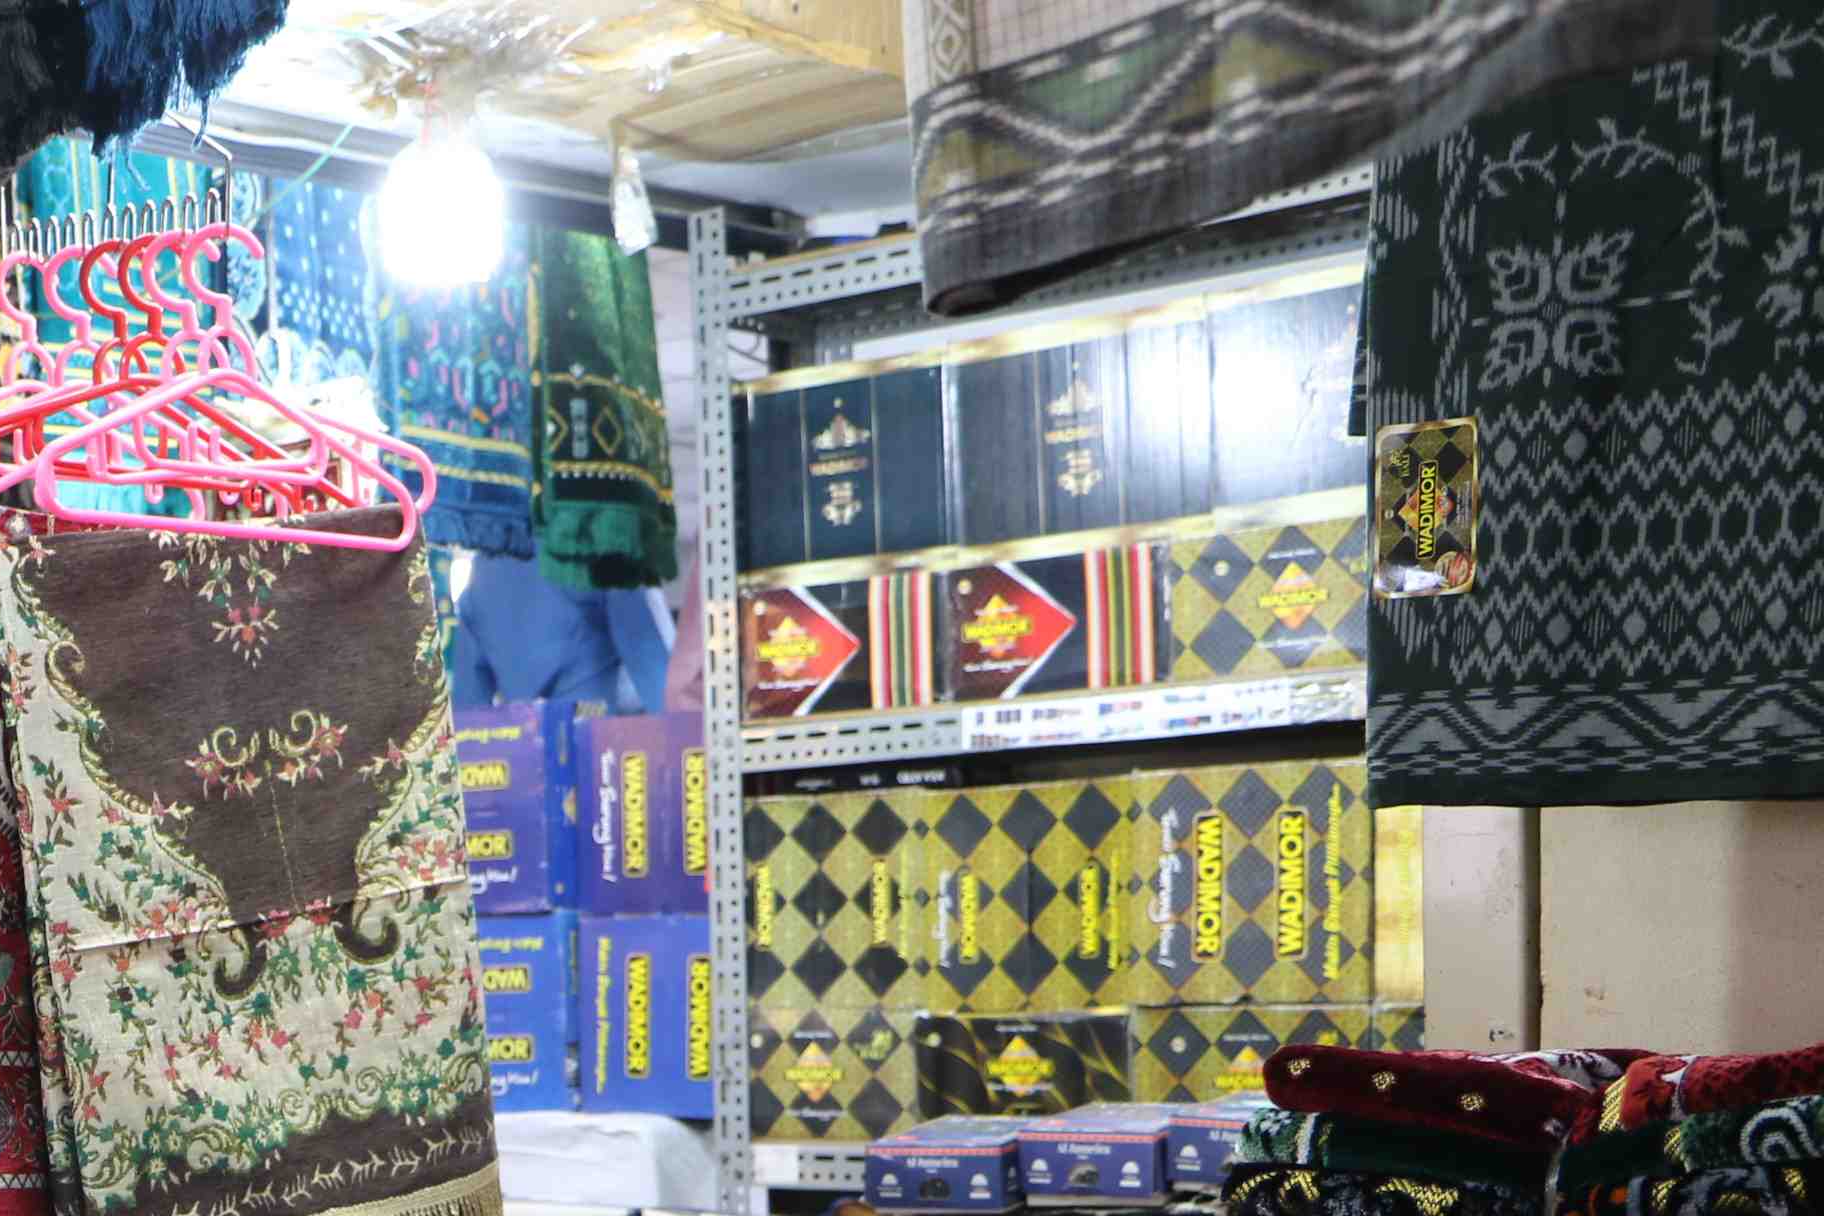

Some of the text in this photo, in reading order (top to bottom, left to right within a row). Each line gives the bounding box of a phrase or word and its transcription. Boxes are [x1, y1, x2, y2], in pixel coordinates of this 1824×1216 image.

[1419, 465, 1436, 556] WADIMOR
[624, 756, 644, 871] WADIMOR
[686, 754, 705, 871] WADIMOR
[1196, 817, 1222, 955] WADIMOR
[1279, 815, 1305, 955] WADIMOR
[629, 957, 649, 1073] WADIMOR
[690, 960, 711, 1075] WADIMOR
